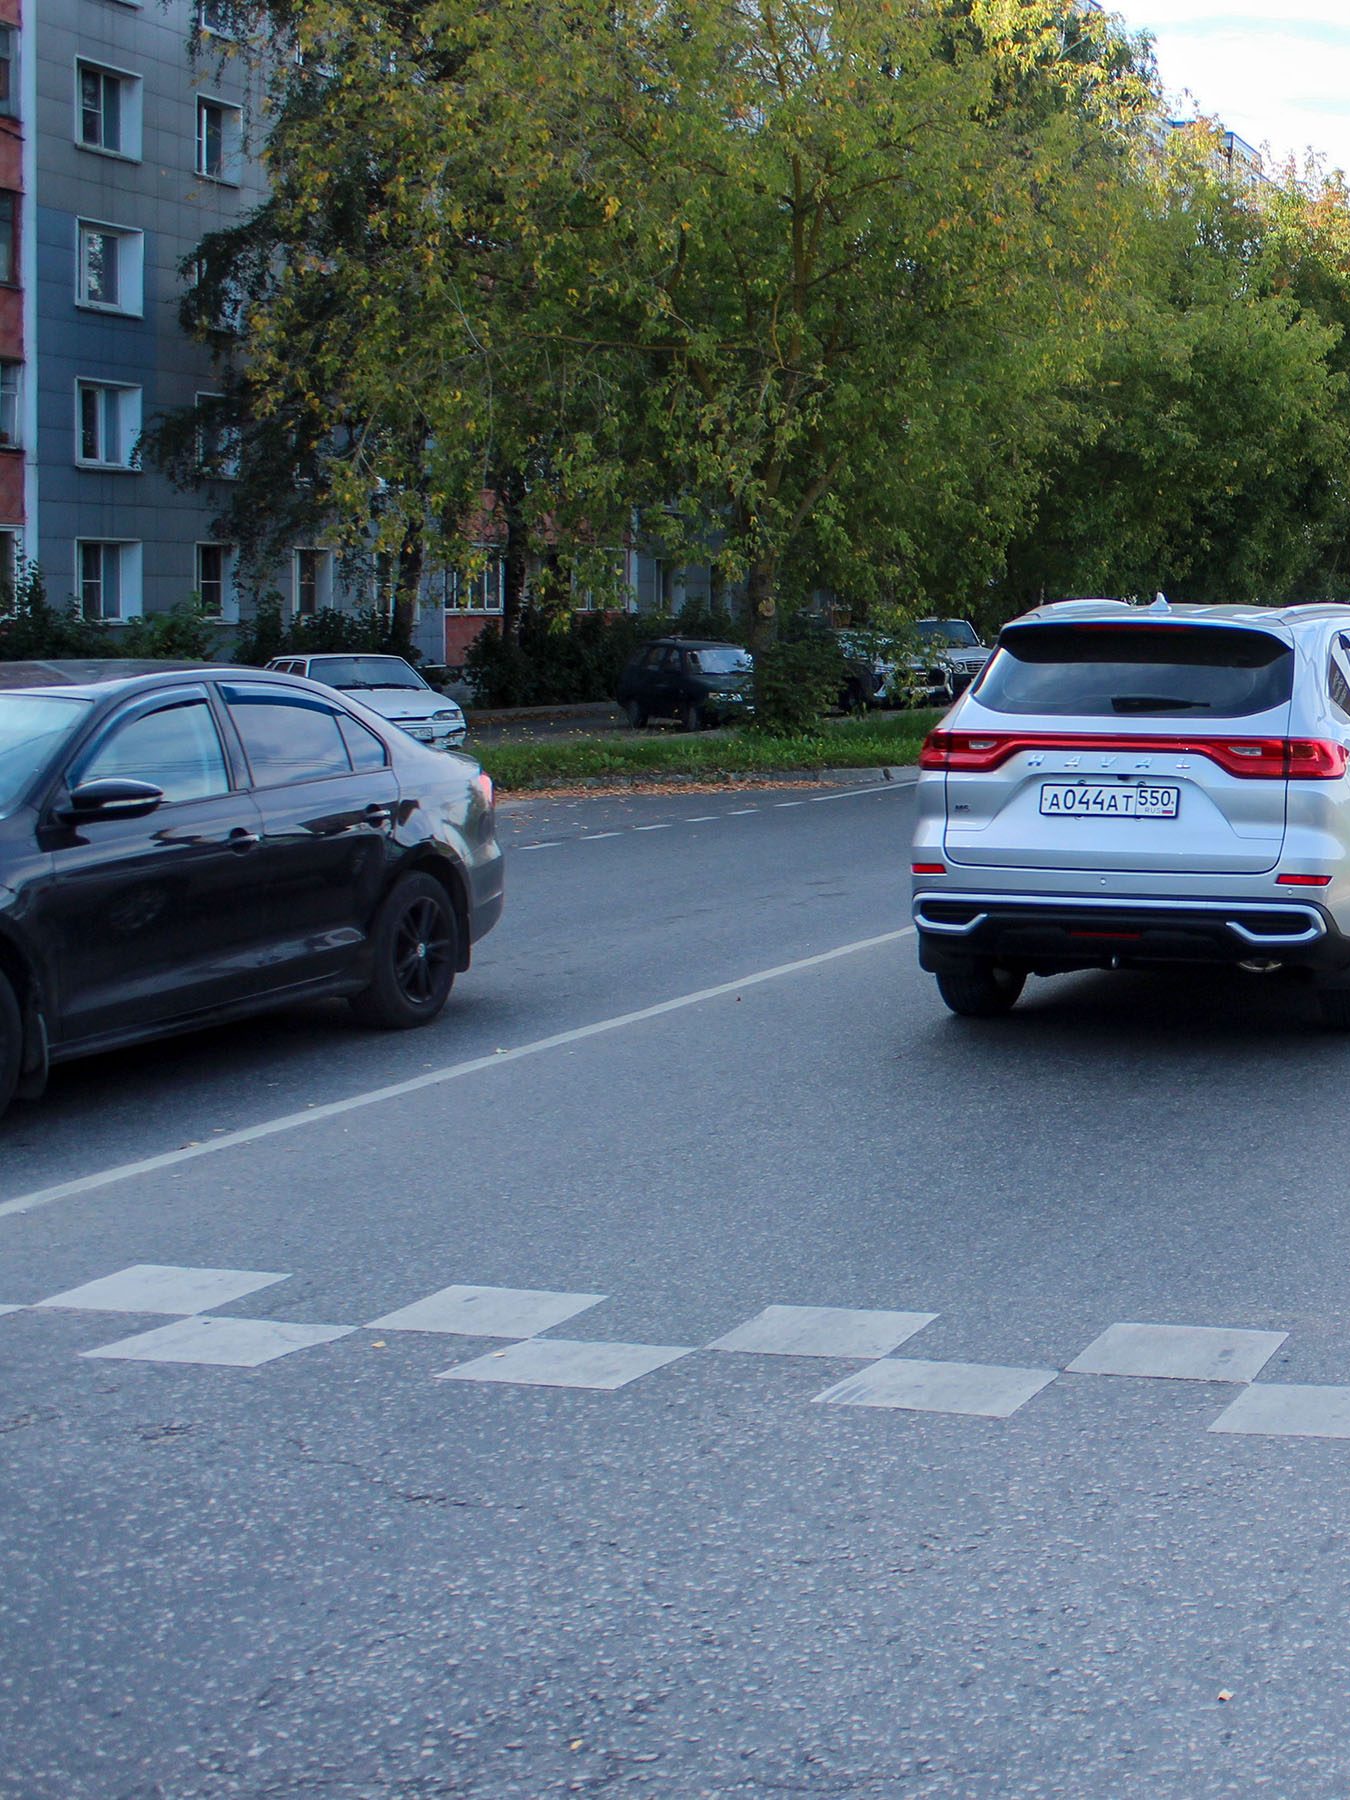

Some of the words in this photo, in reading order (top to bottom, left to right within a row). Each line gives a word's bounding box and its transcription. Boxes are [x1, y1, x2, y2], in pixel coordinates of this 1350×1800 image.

[1027, 754, 1191, 769] HAVAL
[1048, 789, 1134, 812] А044АТ
[1138, 789, 1171, 807] 550
